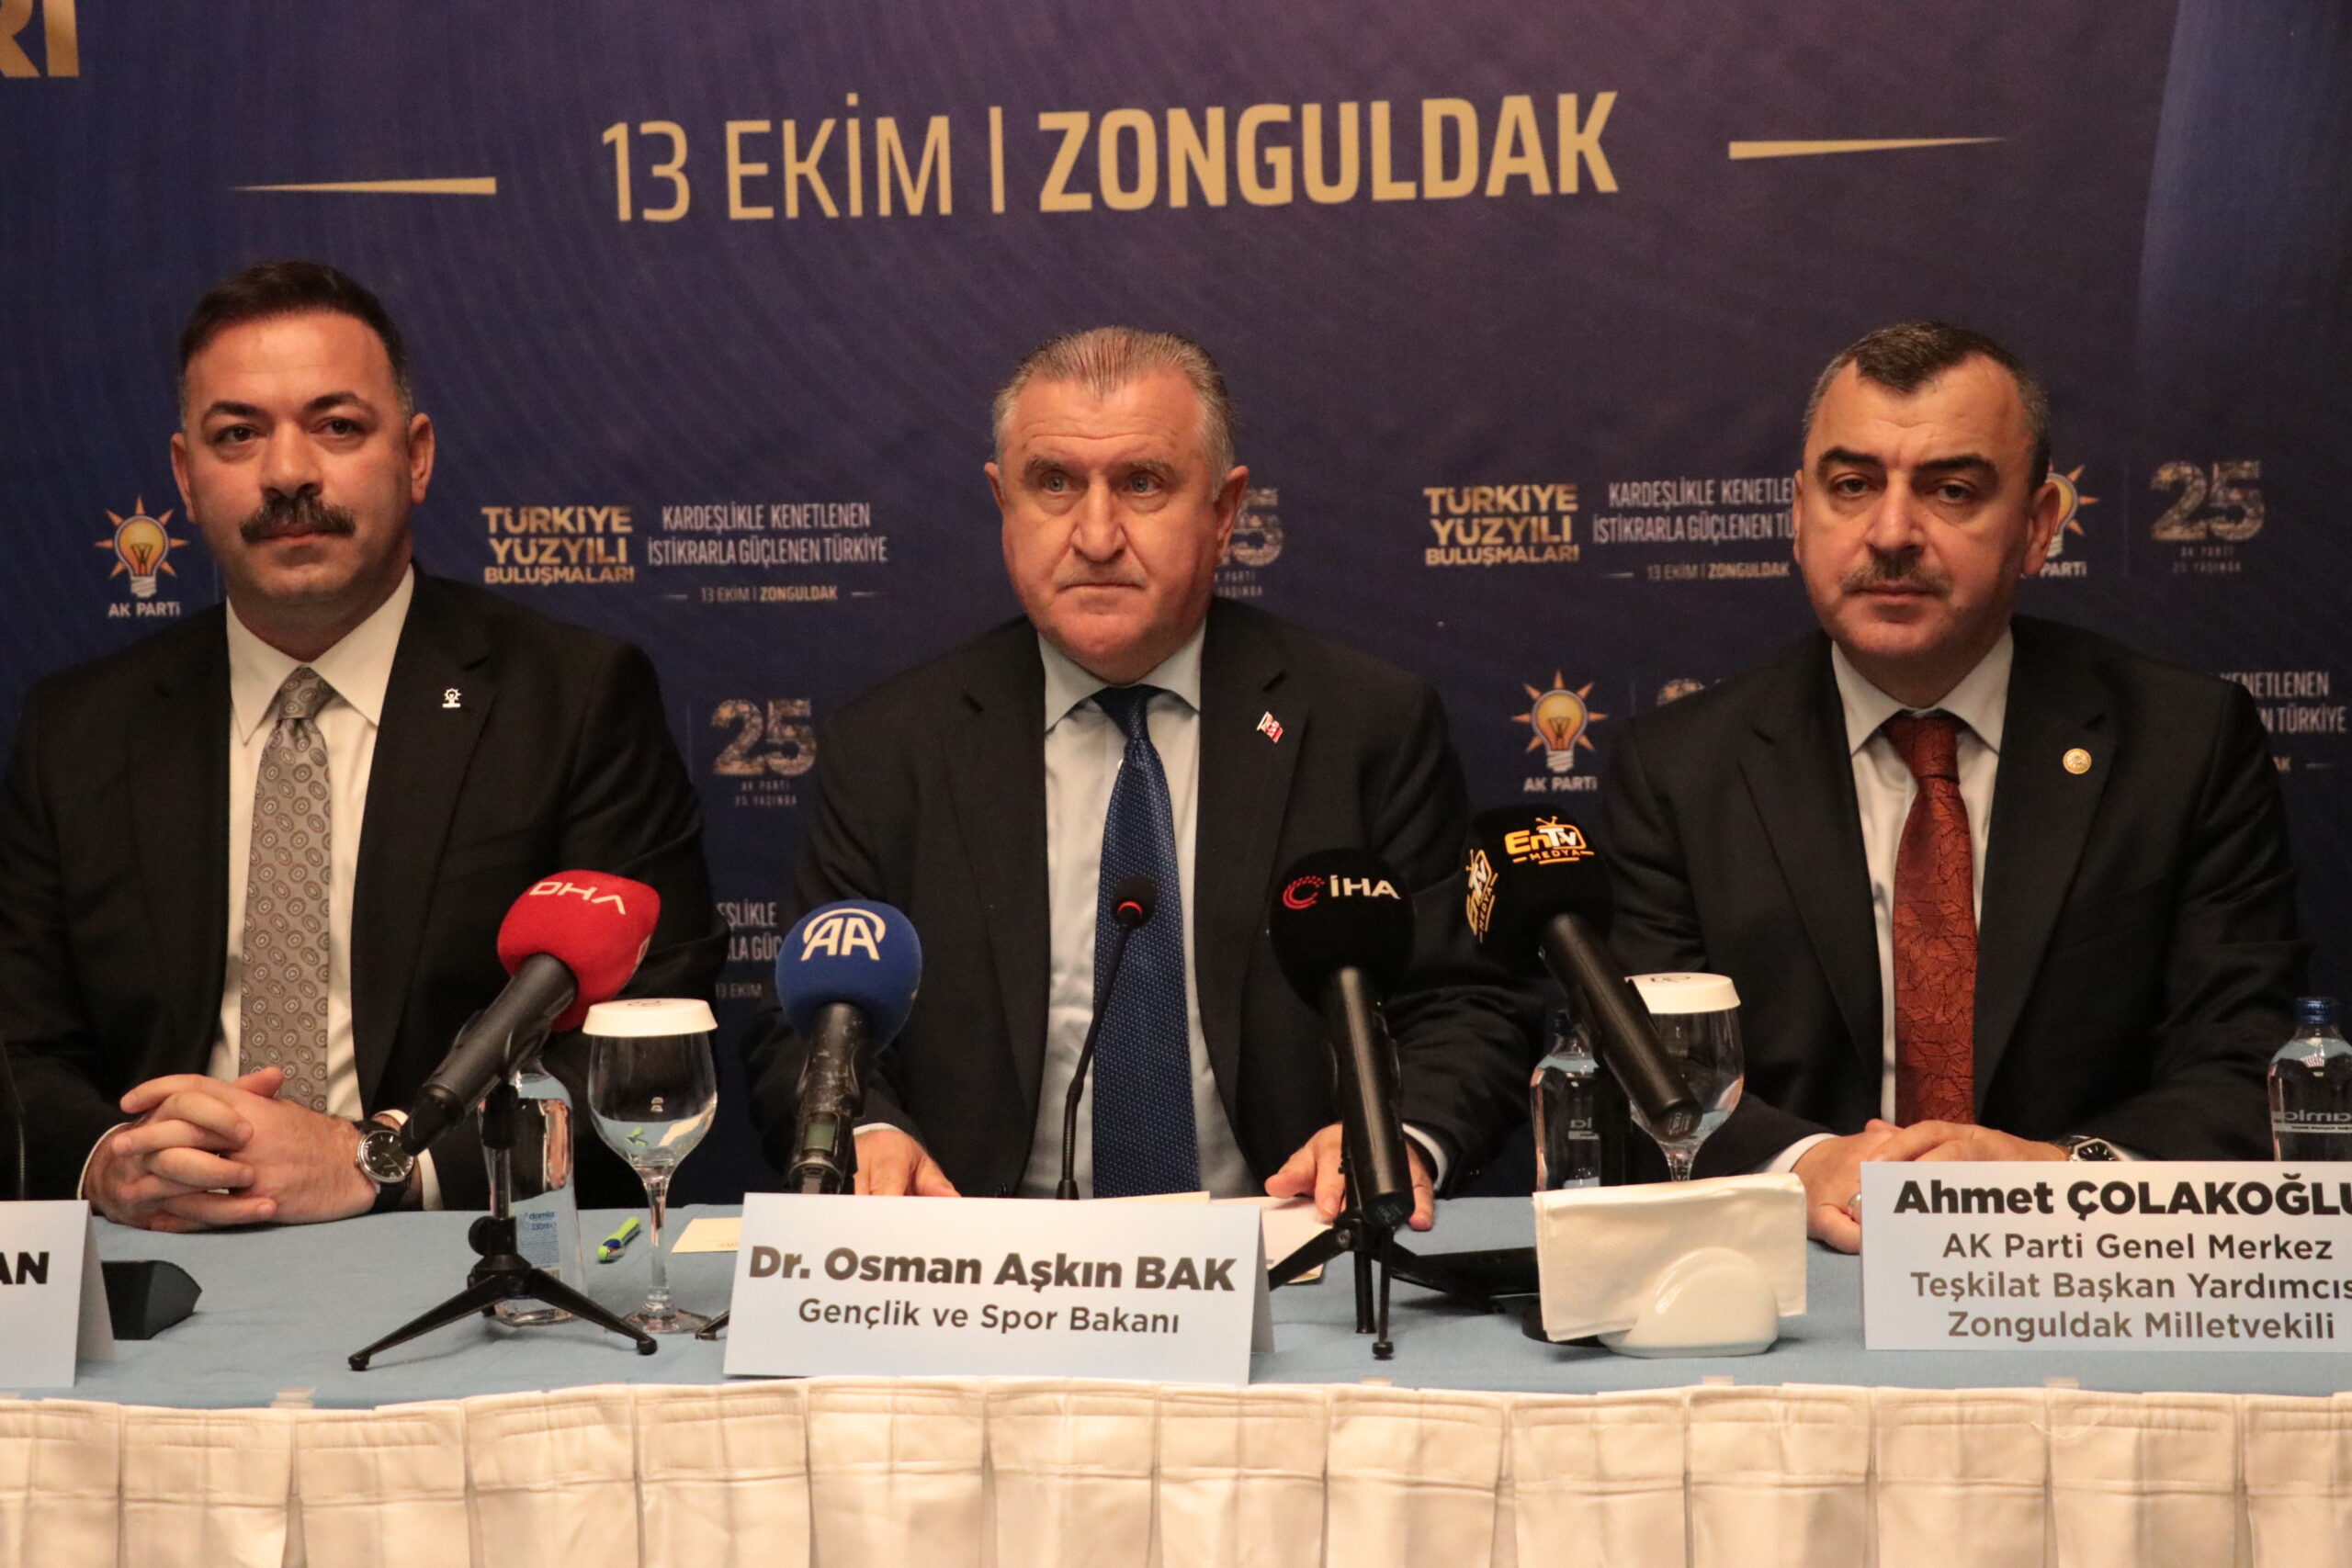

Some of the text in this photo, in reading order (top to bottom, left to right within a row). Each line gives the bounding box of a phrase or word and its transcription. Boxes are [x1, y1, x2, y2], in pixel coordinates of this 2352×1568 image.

[601, 91, 1619, 222] 13 EKİM ZONGULDAK
[1609, 476, 1714, 512] KARDEŞLİKLE
[2151, 461, 2265, 541] 25
[662, 502, 871, 535] KARDEŞLİKLE KENETLENEN
[1227, 488, 1284, 567] 5
[648, 532, 888, 570] İSTİKRARLA GÜÇLENEN TÜRKİYE
[1708, 561, 1790, 580] ZONGULDAK
[107, 603, 131, 618] AK
[760, 585, 839, 603] ZONGULDAK
[711, 698, 818, 776] 25
[1523, 777, 1547, 793] AK
[1530, 848, 1581, 861] MEDYA
[1329, 874, 1401, 900] İHA
[800, 908, 887, 962] AA
[1893, 1179, 2054, 1215] Ahmet
[1942, 1232, 2334, 1259] AK Parti Genel Merkez
[749, 1245, 1237, 1293] Dr. Osman Aşkın BAK
[1910, 1270, 2041, 1303] Teşkilat
[2053, 1271, 2176, 1303] Başkan
[798, 1297, 1180, 1335] Gençlik ve Spor Bakanı
[1948, 1310, 2335, 1343] Zonguldak Milletvekili
